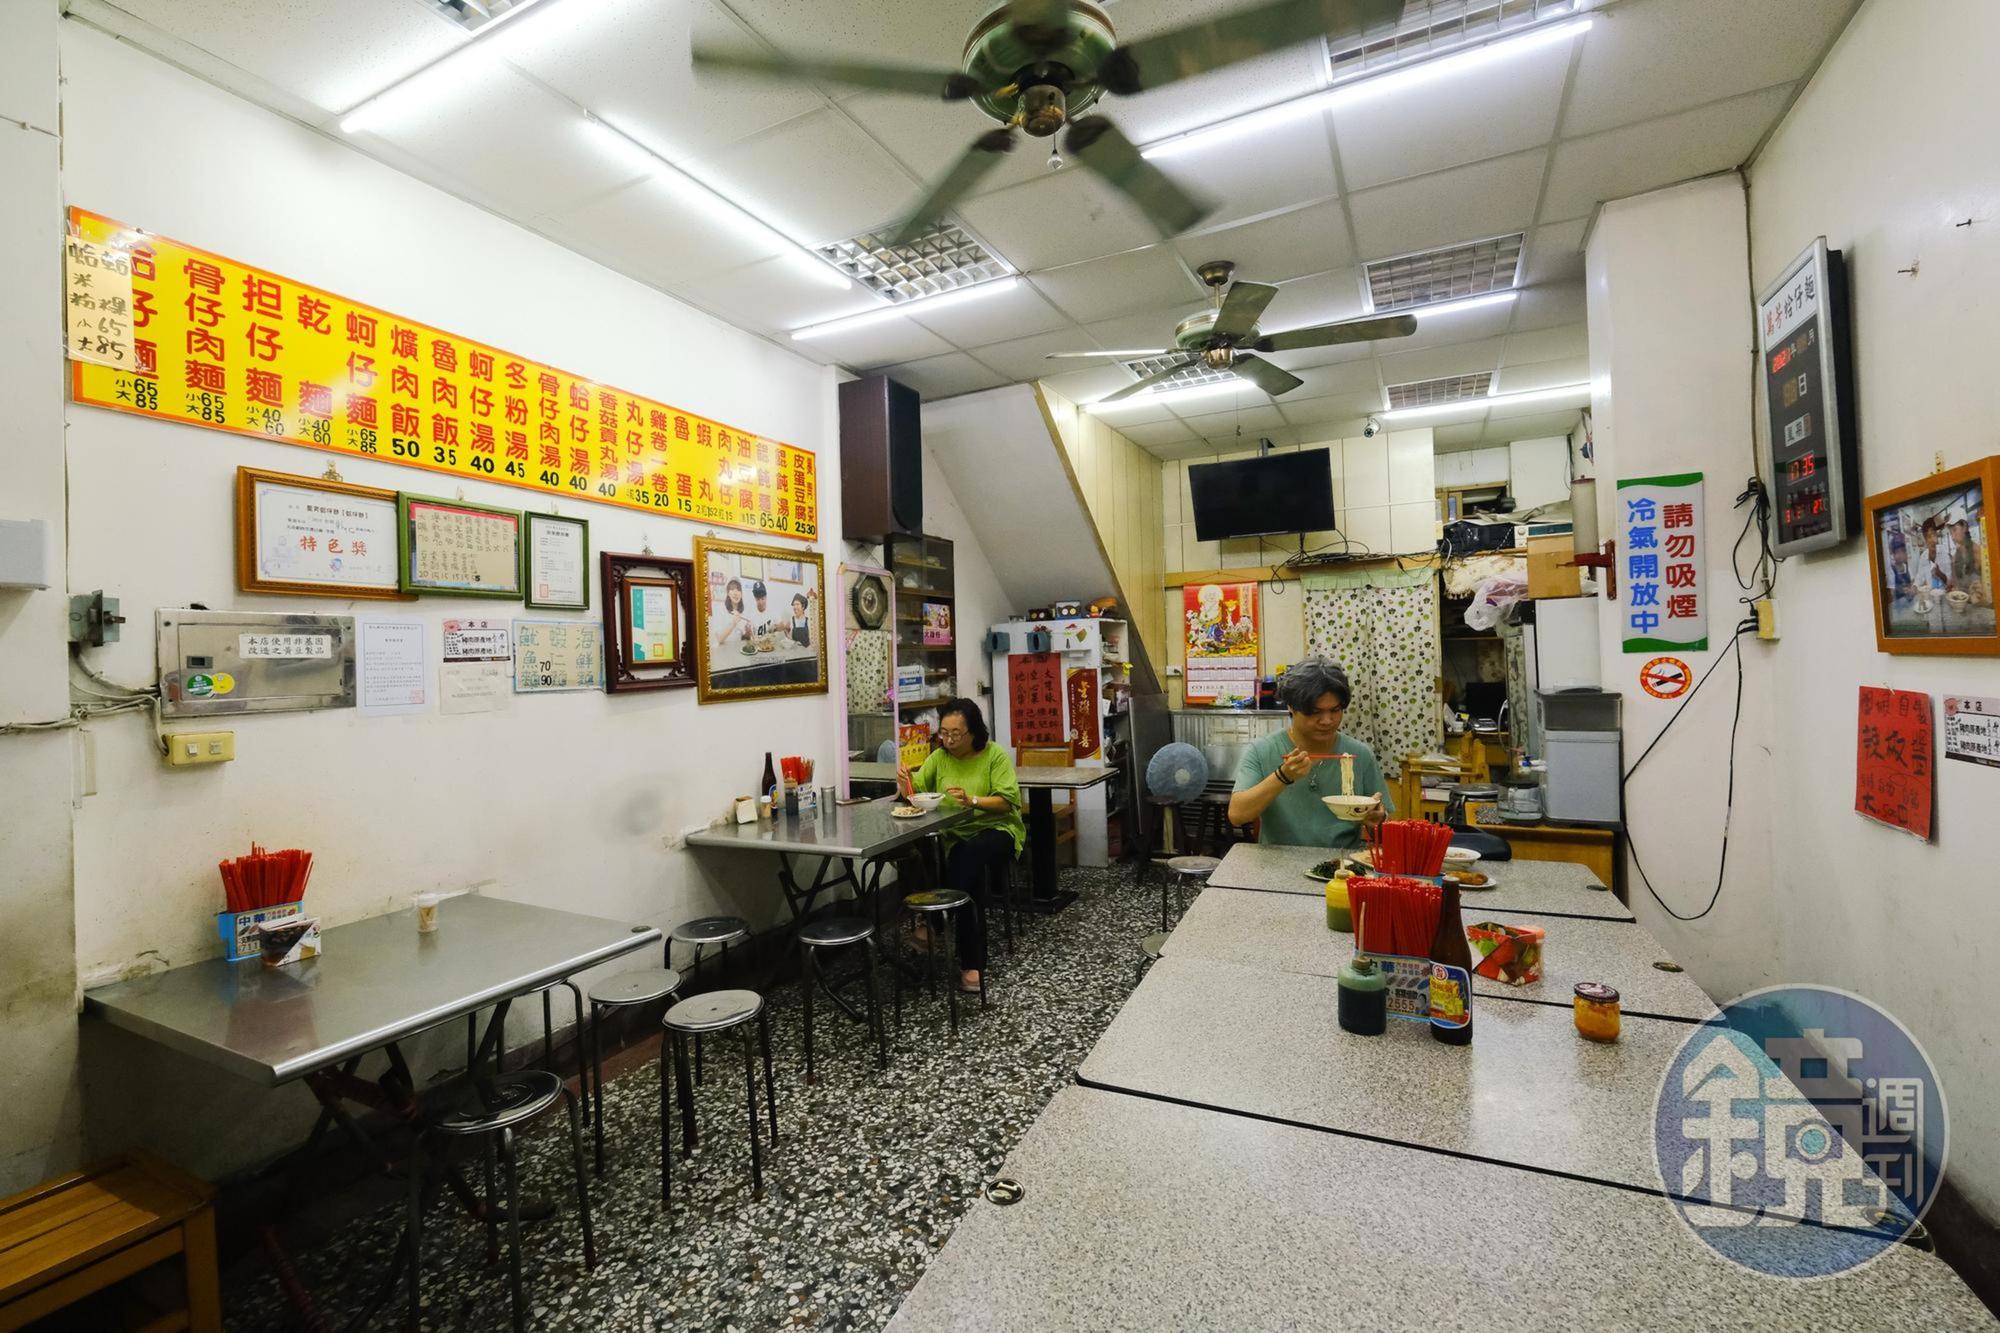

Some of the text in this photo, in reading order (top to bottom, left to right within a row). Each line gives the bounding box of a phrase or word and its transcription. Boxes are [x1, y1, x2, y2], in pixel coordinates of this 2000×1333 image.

[183, 258, 227, 396] 骨仔肉麵
[242, 273, 284, 409] 担仔麵
[297, 294, 333, 421] 乾麵
[346, 311, 379, 431] 蚵仔麵
[431, 339, 459, 466] 魯肉飯 35
[392, 439, 421, 458] 50
[469, 349, 496, 474] 蚵仔湯 40
[504, 361, 529, 478] 冬粉湯 45
[538, 371, 561, 487] 骨仔肉湯 40
[569, 382, 590, 491] 蛤仔湯 40
[626, 400, 644, 486] 丸仔湯
[598, 482, 616, 497] 40
[654, 493, 669, 507] 20
[674, 415, 692, 513] 魯蛋 15
[697, 423, 713, 501] 蝦丸
[737, 436, 753, 511] 油豆腐
[794, 454, 807, 534] 皮蛋豆腐 25
[300, 535, 367, 557] 特色獎
[760, 512, 774, 529] 65
[776, 516, 788, 531] 40
[806, 524, 816, 535] 30
[1627, 497, 1660, 634] 冷氣開放中
[1662, 503, 1698, 619] 請勿吸煙
[467, 620, 488, 628] 本店
[540, 660, 551, 672] 70
[541, 674, 552, 686] 90
[1964, 700, 1982, 711] 本店
